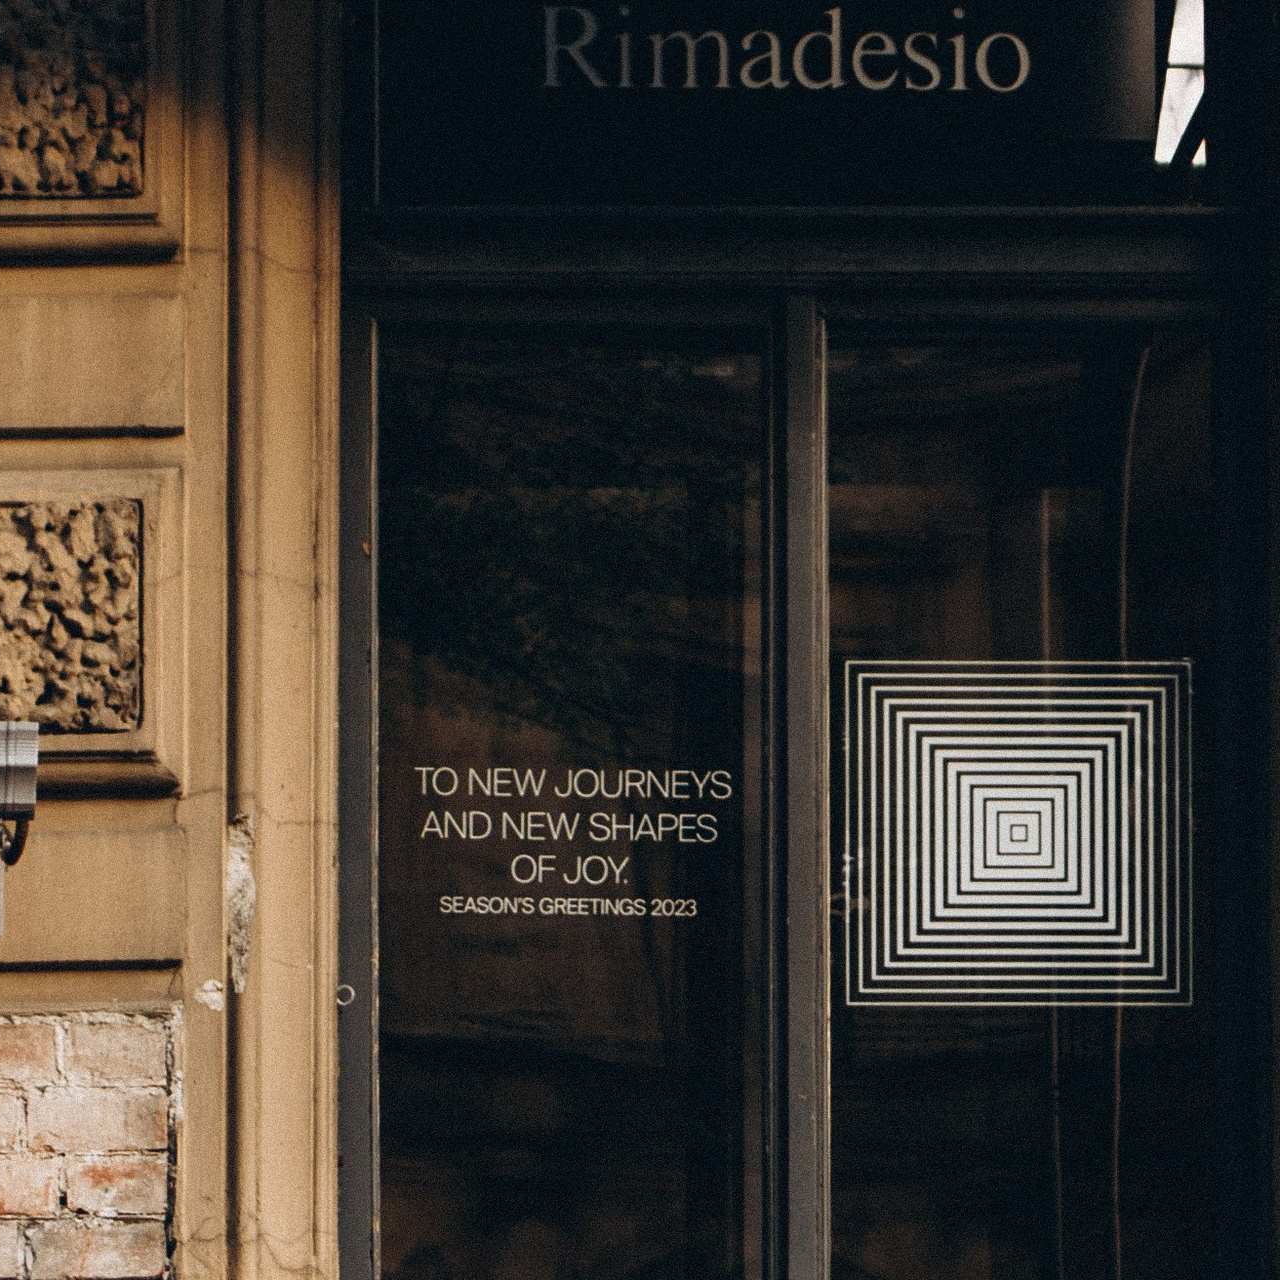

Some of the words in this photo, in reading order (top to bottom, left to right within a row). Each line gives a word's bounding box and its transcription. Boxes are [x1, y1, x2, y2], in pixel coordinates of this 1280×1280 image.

[541, 5, 1031, 93] Rimadesio
[414, 766, 459, 797] TO
[468, 767, 547, 797] NEW
[554, 768, 733, 800] JOURNEYS
[420, 810, 493, 840] AND
[501, 811, 580, 841] NEW
[588, 812, 719, 843] SHAPES
[510, 854, 556, 884] OF
[562, 855, 629, 885] JOY.
[439, 895, 535, 915] SEASON'S
[538, 896, 647, 916] GREETINGS
[650, 898, 697, 917] 2023
